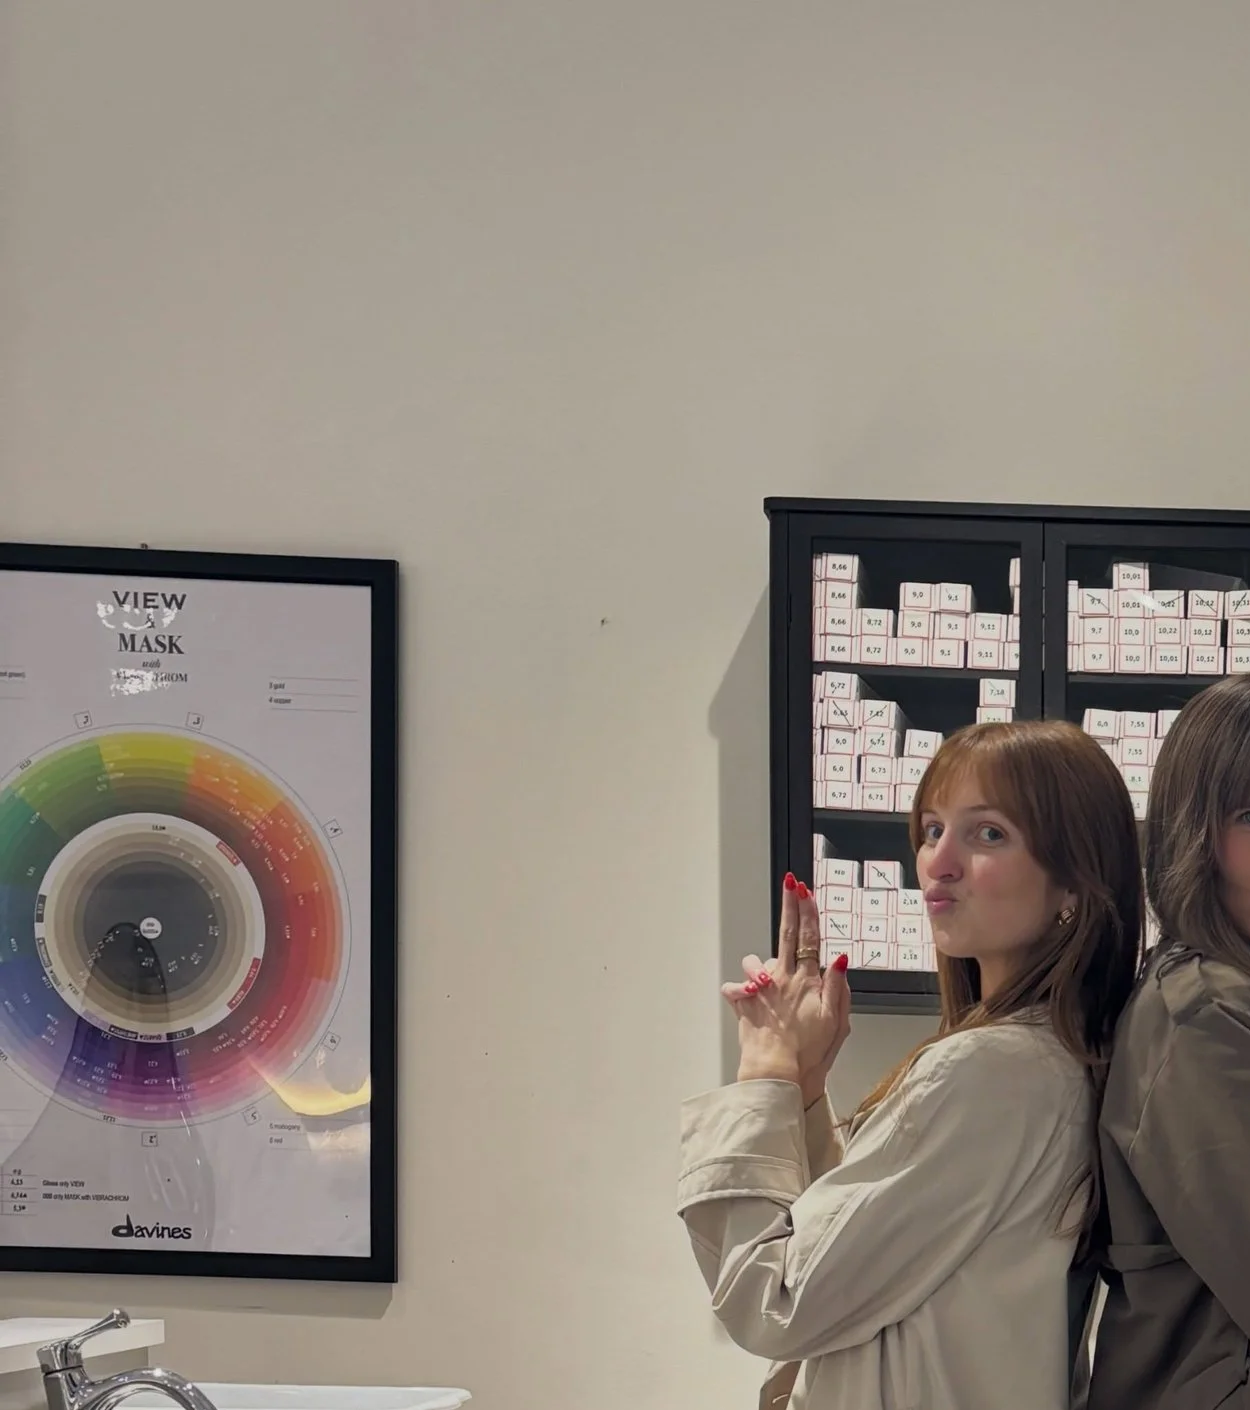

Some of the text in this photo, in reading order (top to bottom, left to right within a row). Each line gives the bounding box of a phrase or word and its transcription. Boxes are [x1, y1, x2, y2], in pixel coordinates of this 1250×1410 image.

[112, 591, 186, 610] VIEW
[117, 633, 184, 654] MASK
[112, 1214, 192, 1240] davines
